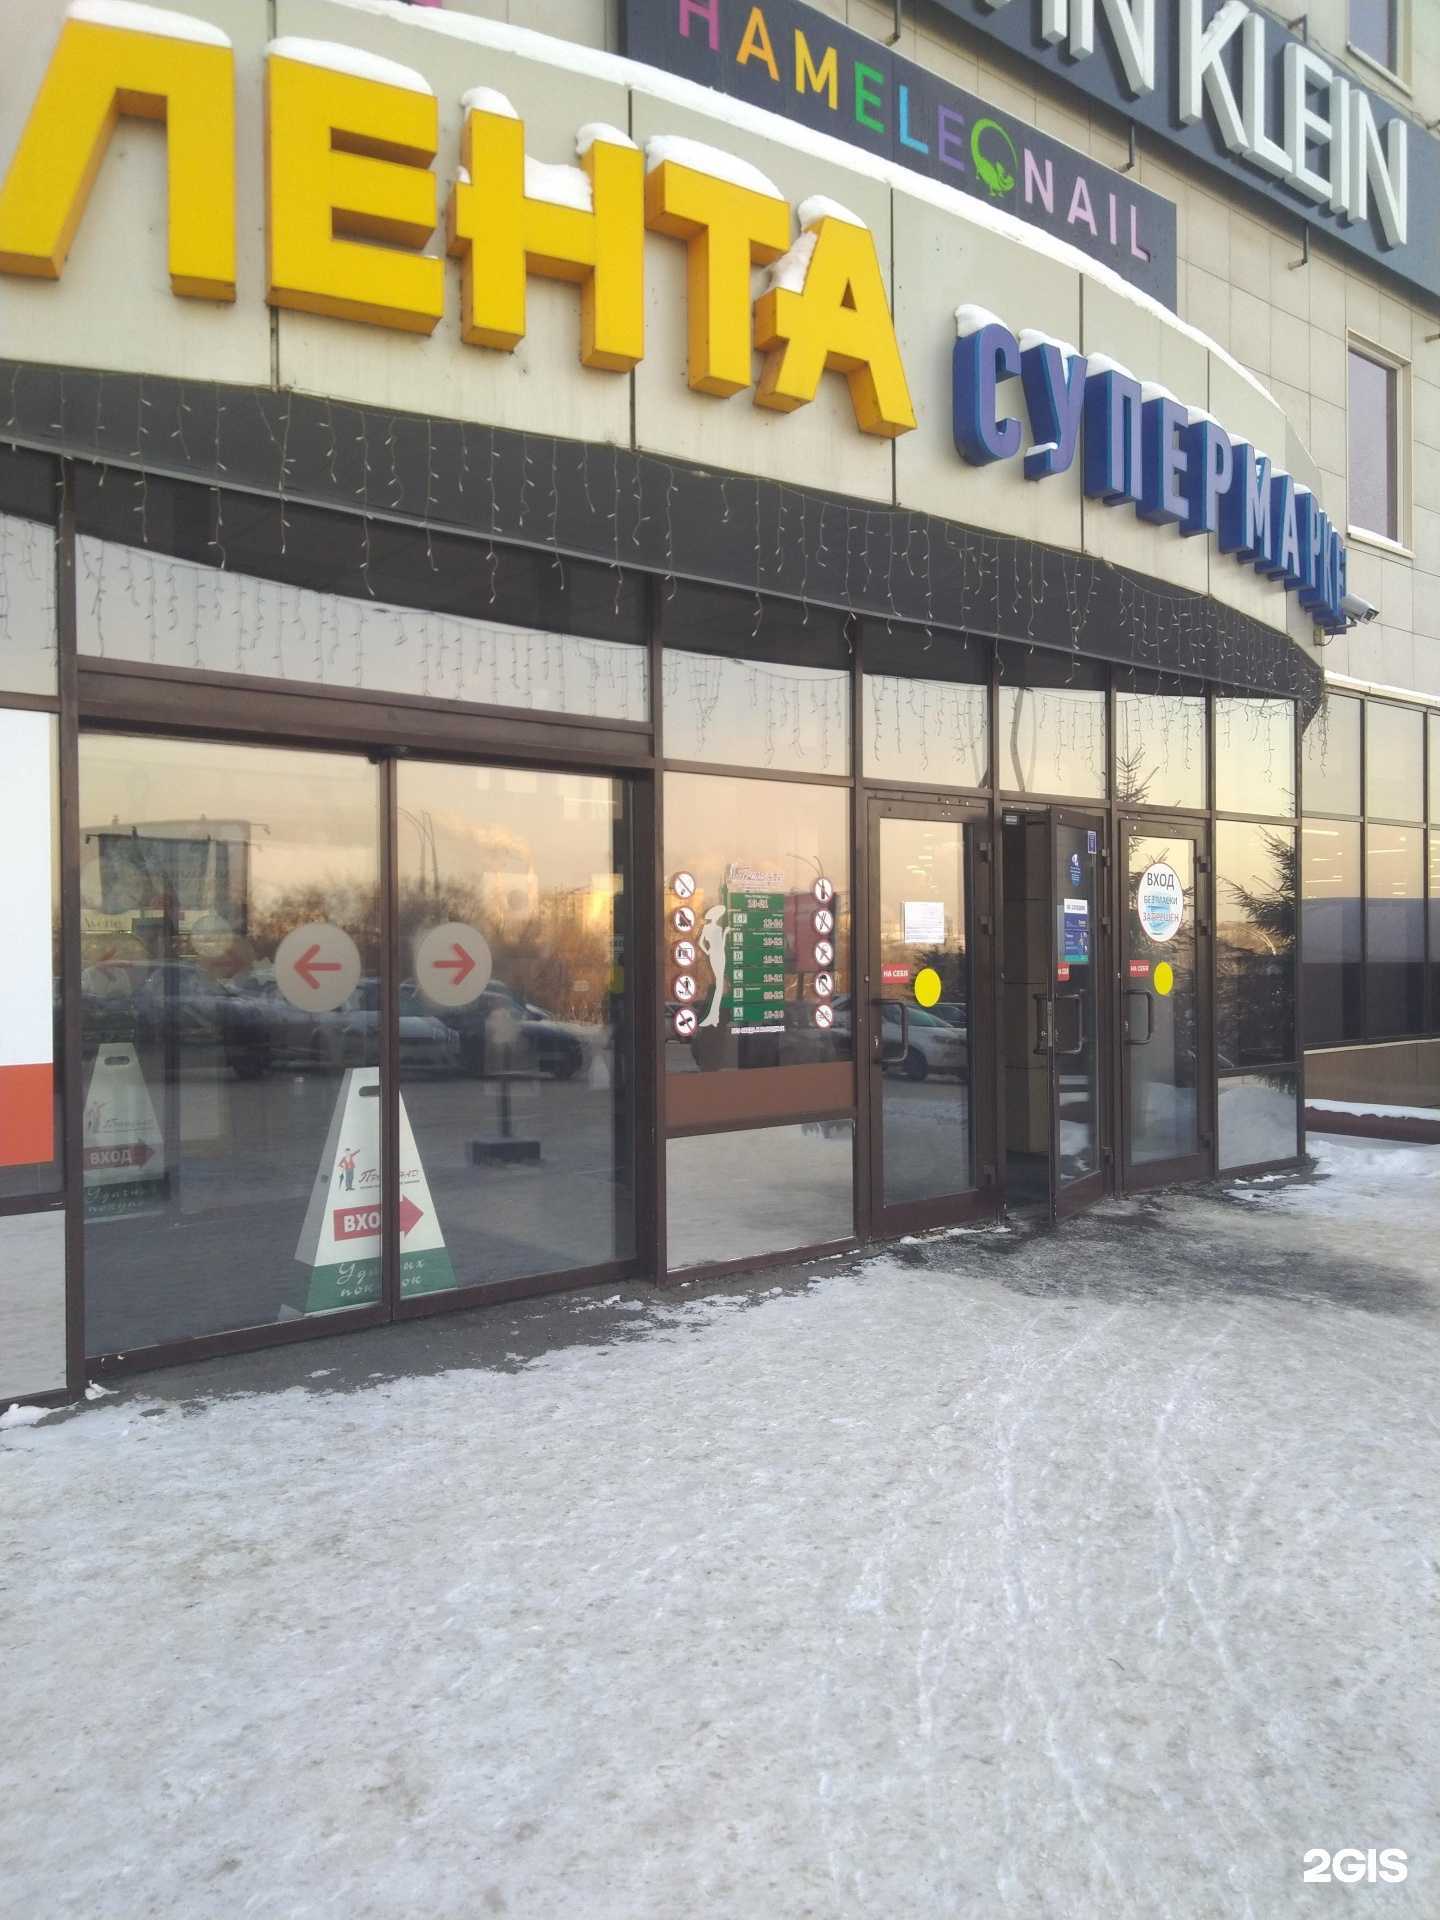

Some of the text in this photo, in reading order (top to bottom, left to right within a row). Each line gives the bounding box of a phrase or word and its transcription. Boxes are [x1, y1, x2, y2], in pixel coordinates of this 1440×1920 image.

[1179, 0, 1408, 250] KLEIN
[0, 20, 918, 439] ЛЕНТА
[953, 323, 1347, 634] СУПЕРМАРКЕ
[1147, 873, 1174, 891] ВХОД
[892, 969, 909, 977] СЕБЯ
[89, 1150, 133, 1166] ВХОД
[342, 1211, 381, 1233] ВХО
